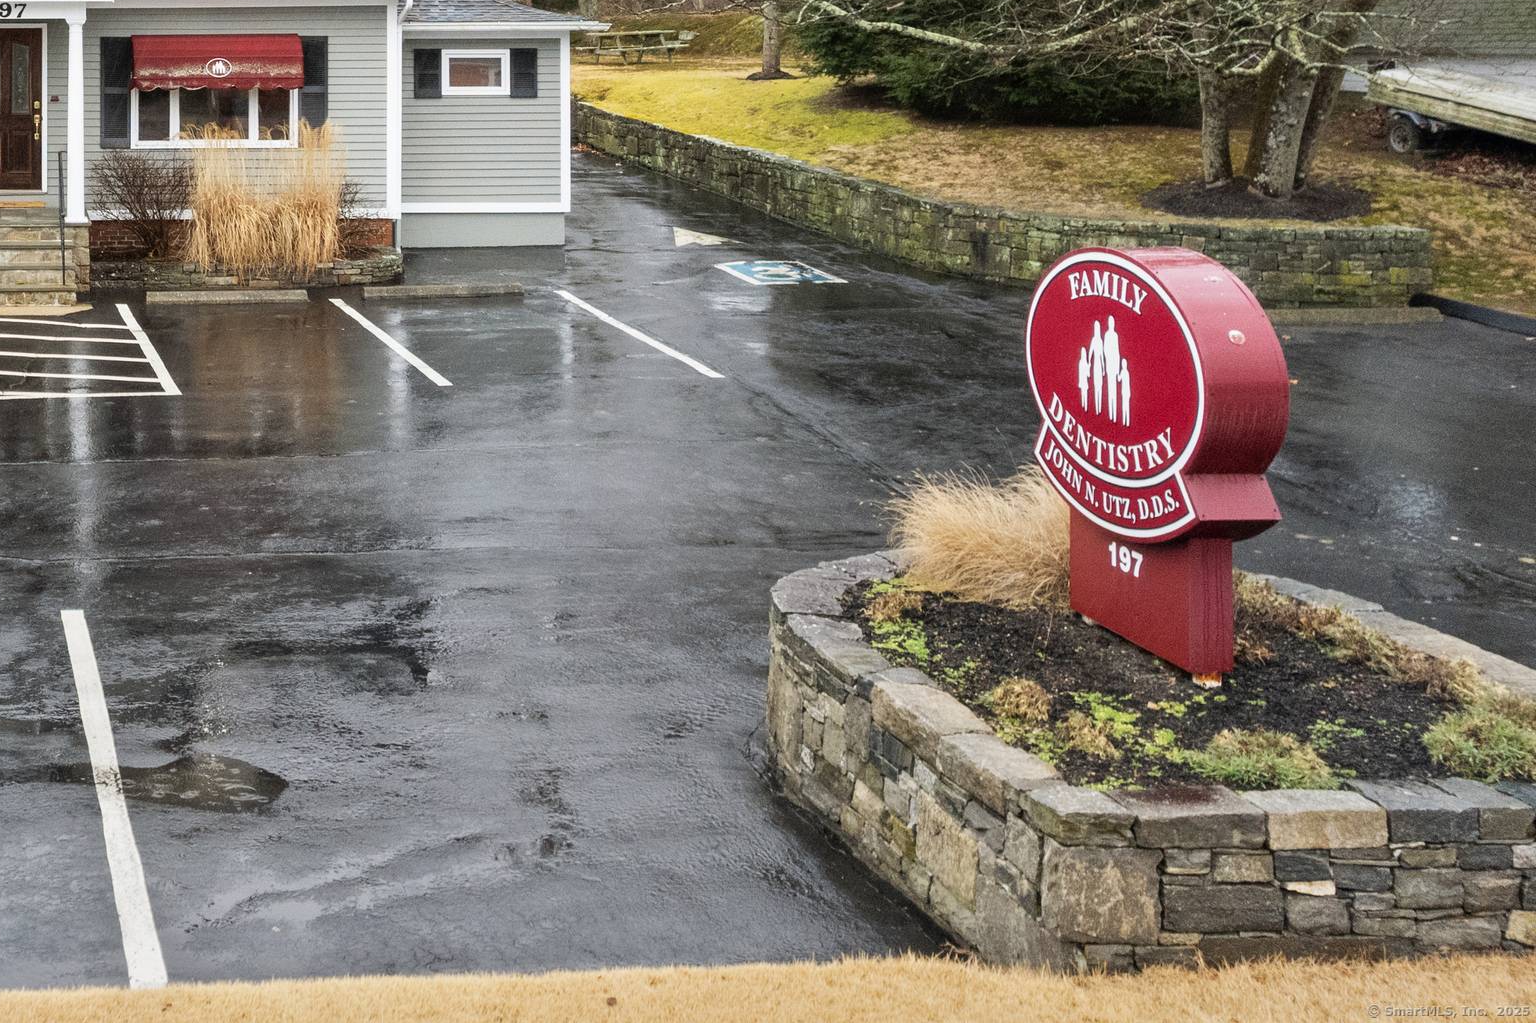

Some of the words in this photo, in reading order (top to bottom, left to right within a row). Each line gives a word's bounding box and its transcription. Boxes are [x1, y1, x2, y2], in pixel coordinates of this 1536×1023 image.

[1068, 269, 1148, 315] FAMILY
[1048, 392, 1176, 473] DENTISTRY
[1044, 439, 1083, 489] JOHN
[1085, 488, 1099, 508] N.
[1103, 495, 1137, 524] UTZ,
[1139, 490, 1180, 521] D.D.S.
[1108, 542, 1144, 578] 197
